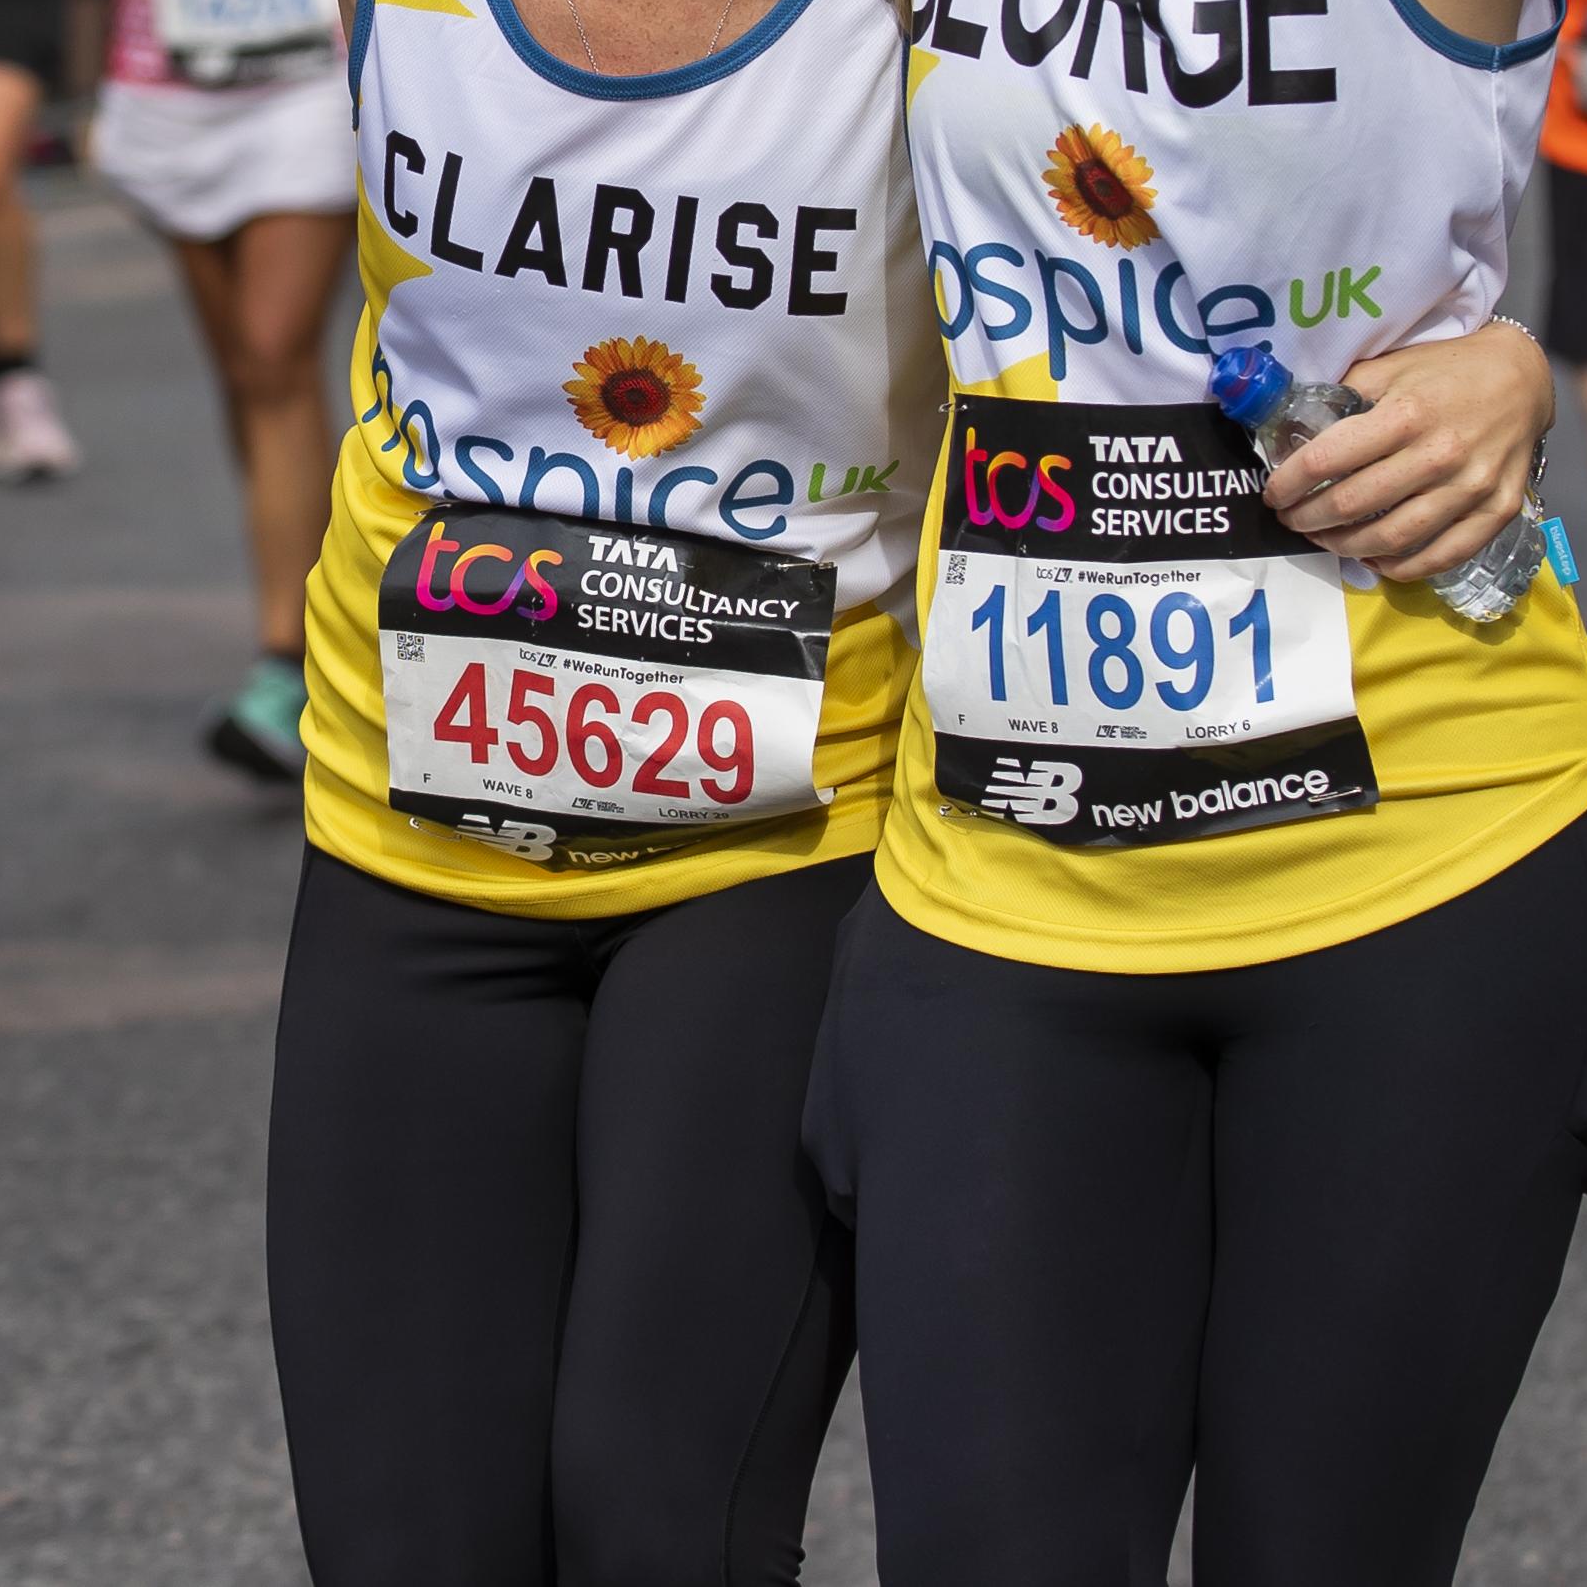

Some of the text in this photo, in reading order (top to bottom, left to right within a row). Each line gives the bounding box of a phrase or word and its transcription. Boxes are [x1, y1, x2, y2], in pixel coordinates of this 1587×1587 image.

[383, 129, 858, 317] CLARISE
[928, 240, 1383, 381] ospice UK
[1089, 436, 1183, 463] TATA
[807, 459, 900, 503] UK
[965, 426, 1076, 532] tcs
[1091, 468, 1267, 500] CONSULTAN
[1091, 506, 1231, 536] SERVICES
[416, 520, 563, 621] tcs
[588, 534, 679, 573] TATA
[580, 569, 801, 619] CONSULTANCY
[1078, 570, 1201, 587] #WeRunTogether
[576, 603, 714, 645] SERVICES
[971, 583, 1275, 712] 11891
[563, 658, 685, 685] #WeRunTogether
[432, 662, 756, 806] 45629
[958, 714, 966, 725] F
[1008, 718, 1048, 733] WAVE
[1051, 722, 1059, 734] 8
[1185, 723, 1236, 739] LORRY
[1242, 719, 1251, 731] 6
[423, 773, 432, 784] F
[482, 778, 522, 797] WAVE
[525, 788, 534, 799] 8
[658, 807, 709, 820] LORRY
[1091, 800, 1163, 828] new
[1170, 769, 1330, 820] balance
[567, 848, 640, 865] new
